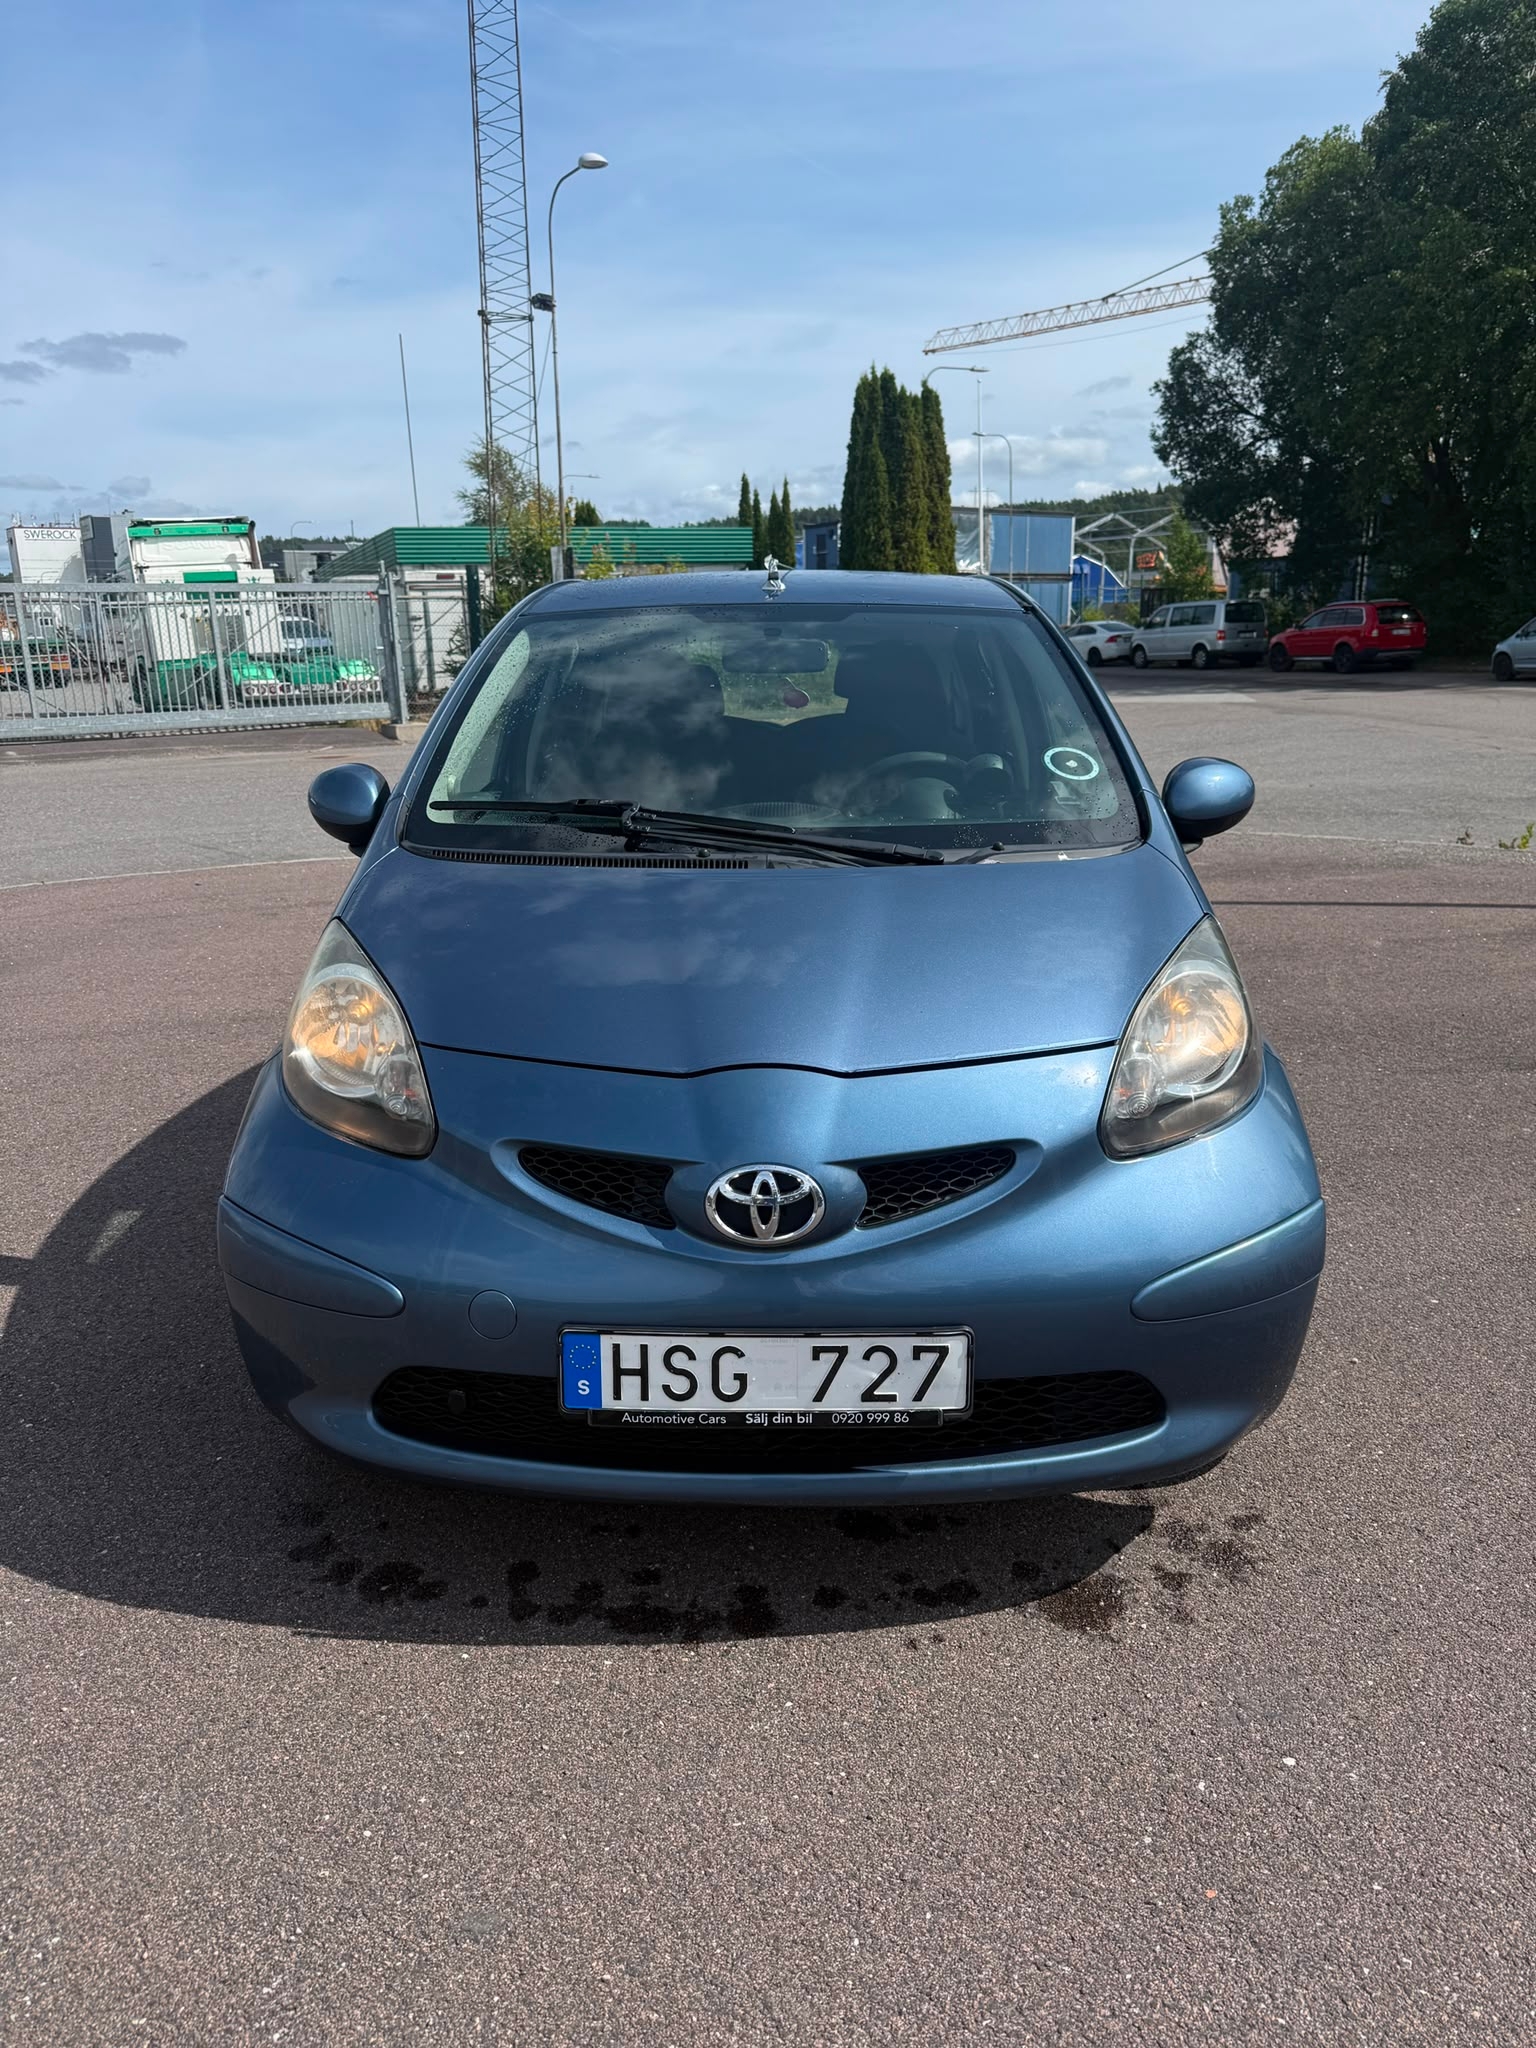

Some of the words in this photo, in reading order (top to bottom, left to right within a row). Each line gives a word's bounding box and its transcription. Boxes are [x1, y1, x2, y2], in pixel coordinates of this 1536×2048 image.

[23, 529, 76, 539] SWEROCK
[612, 1344, 748, 1402] HSG
[811, 1345, 950, 1402] 727
[578, 1380, 590, 1395] S
[621, 1412, 695, 1425] Automotive
[698, 1413, 727, 1425] Cars
[745, 1412, 769, 1426] Sälj
[772, 1412, 792, 1424] din
[796, 1412, 813, 1424] bil
[831, 1412, 863, 1424] 0920
[866, 1412, 891, 1423] 999
[893, 1412, 910, 1423] 86
